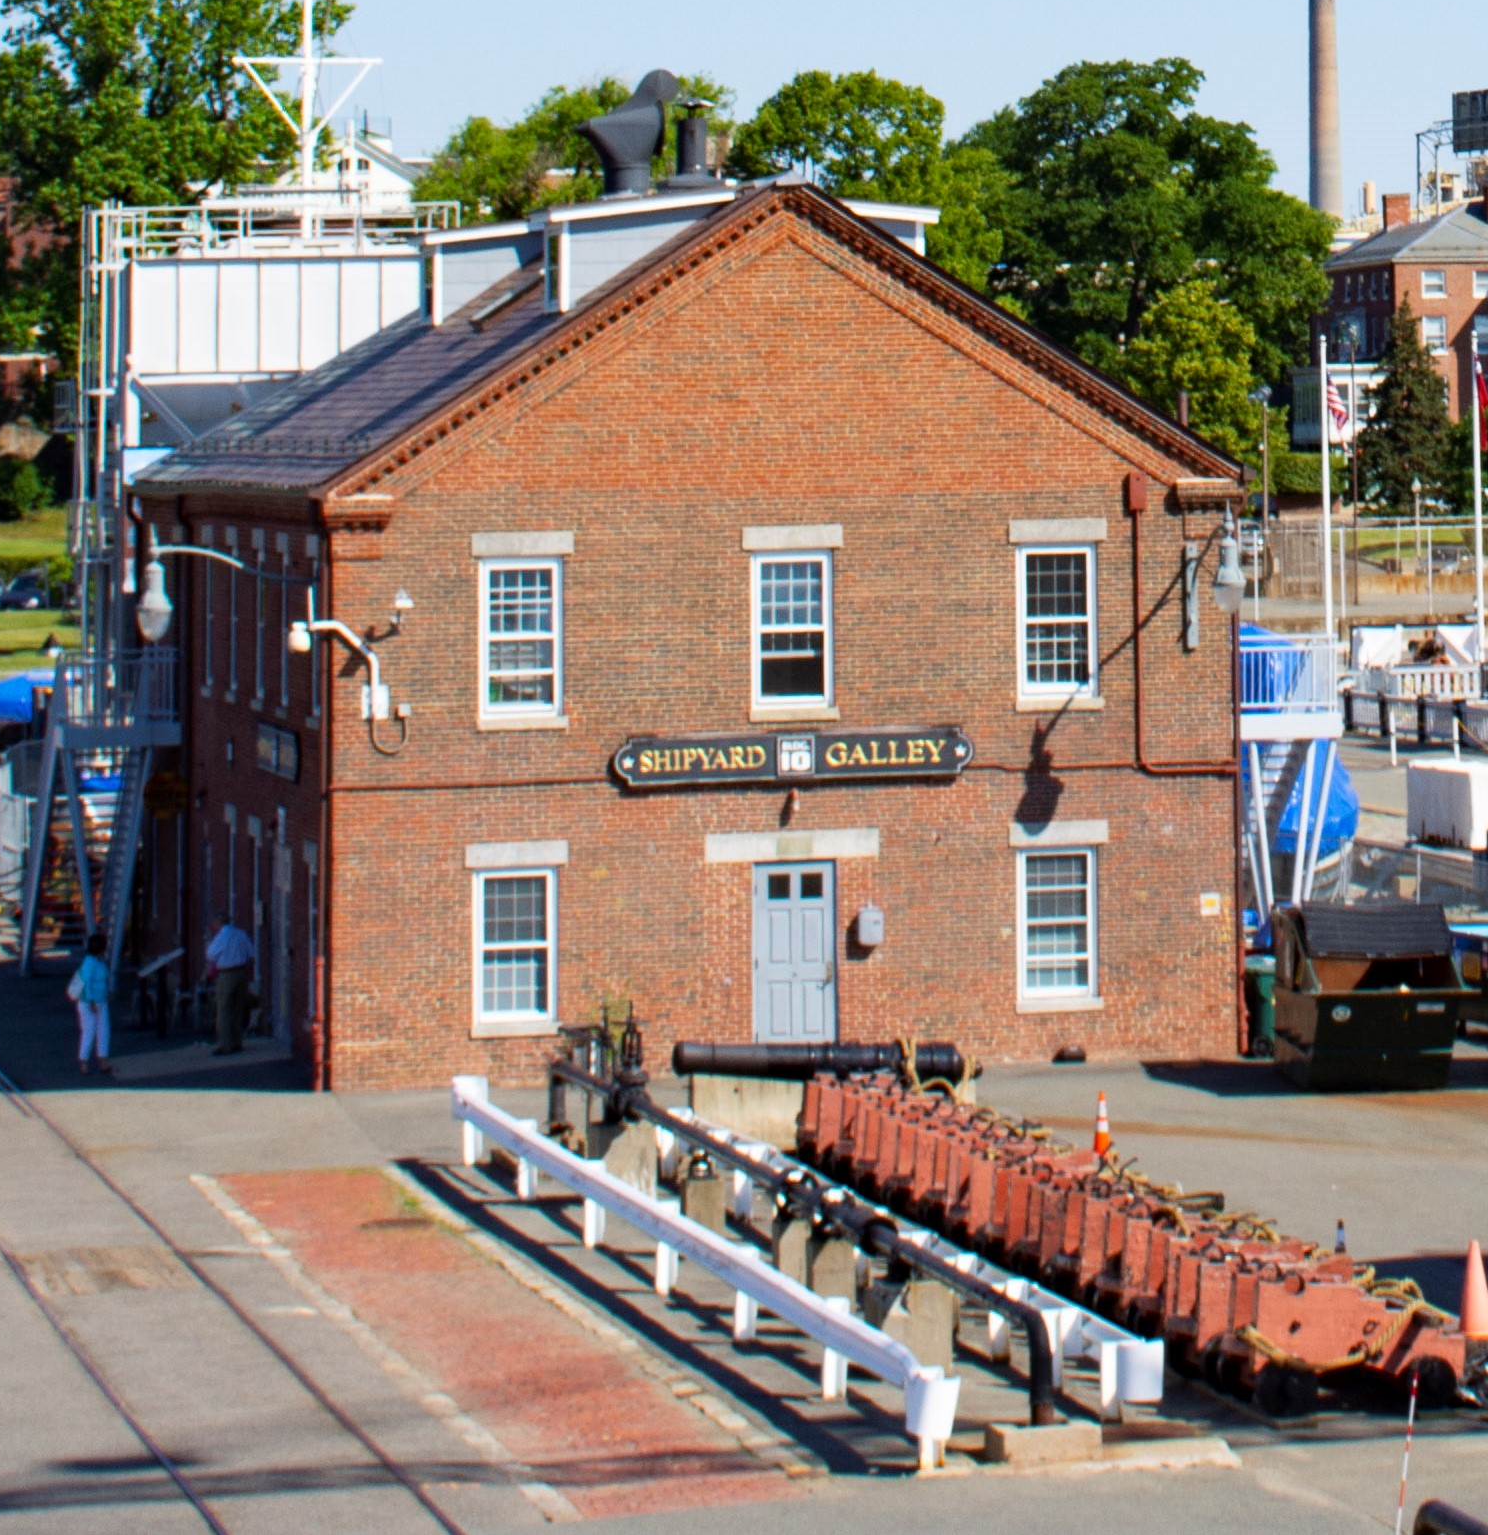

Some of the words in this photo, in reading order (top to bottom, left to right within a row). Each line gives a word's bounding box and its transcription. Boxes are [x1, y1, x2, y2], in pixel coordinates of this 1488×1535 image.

[639, 745, 767, 773] SHIPYARD
[825, 739, 947, 767] GALLEY
[781, 751, 811, 771] 10
